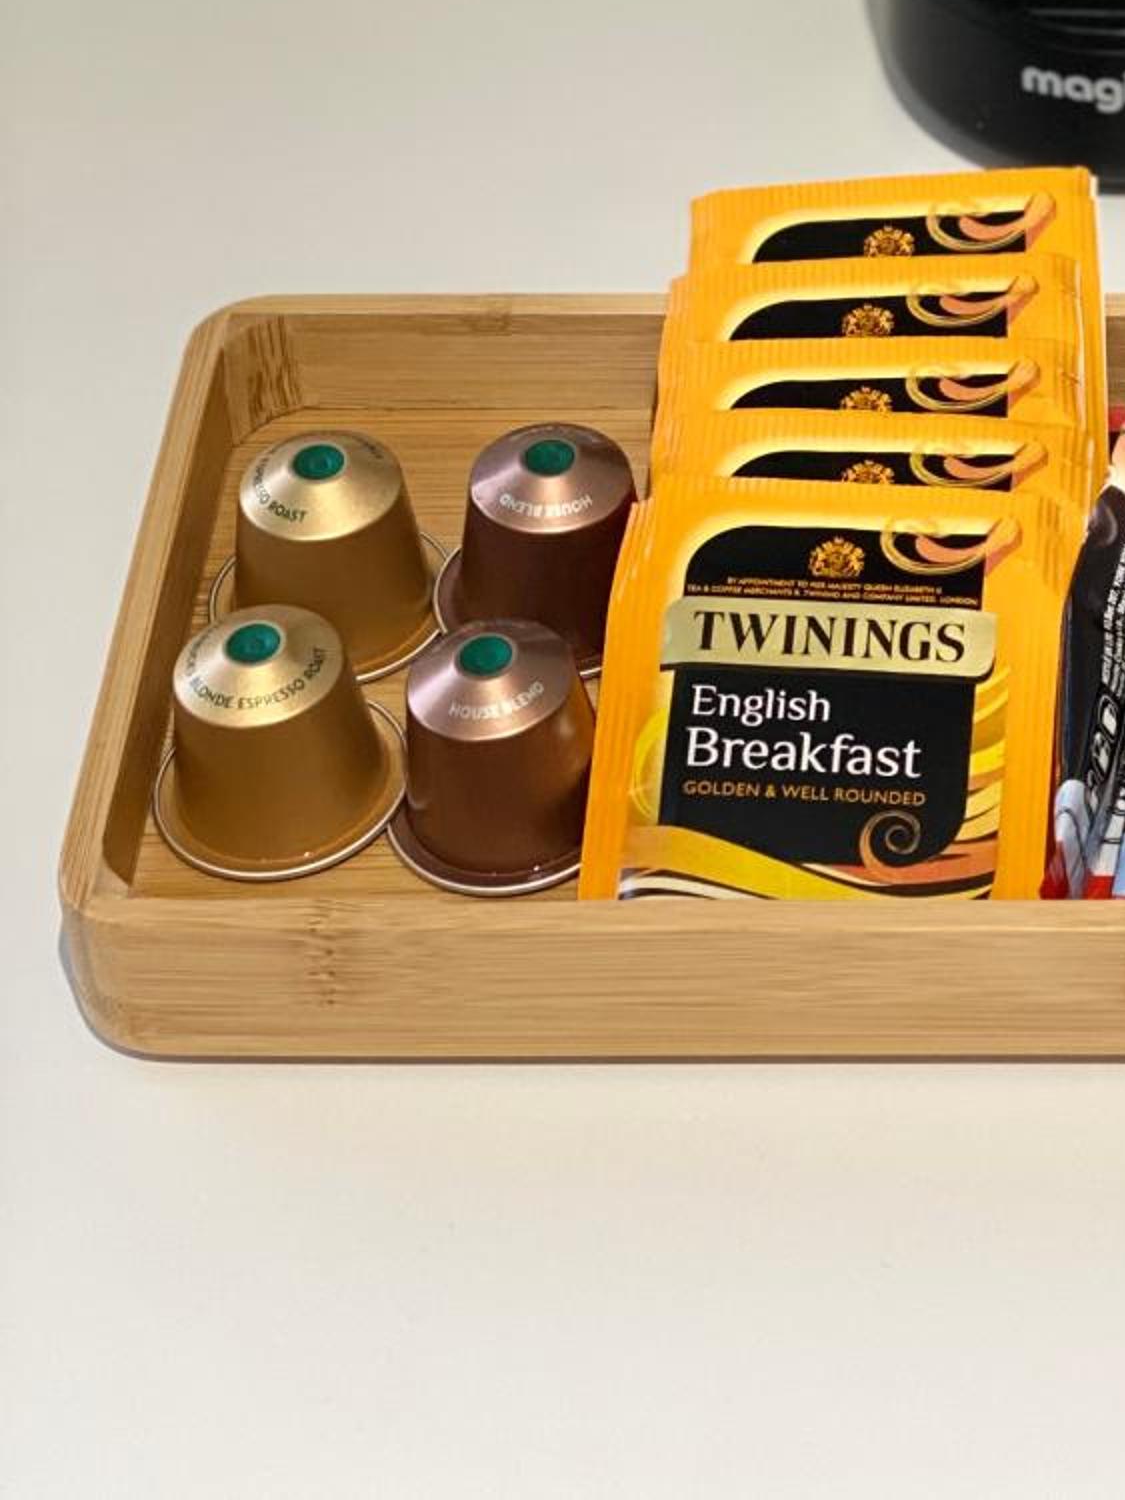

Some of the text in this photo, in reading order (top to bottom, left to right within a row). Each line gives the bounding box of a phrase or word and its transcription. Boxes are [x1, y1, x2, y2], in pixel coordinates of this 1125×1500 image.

[267, 500, 308, 523] ROAST
[694, 610, 965, 663] TWININGS
[237, 678, 305, 710] ESPRESSO
[692, 684, 831, 727] English
[685, 726, 922, 779] Breakfast
[682, 779, 926, 807] GOLDEN & WELL ROUNDED
